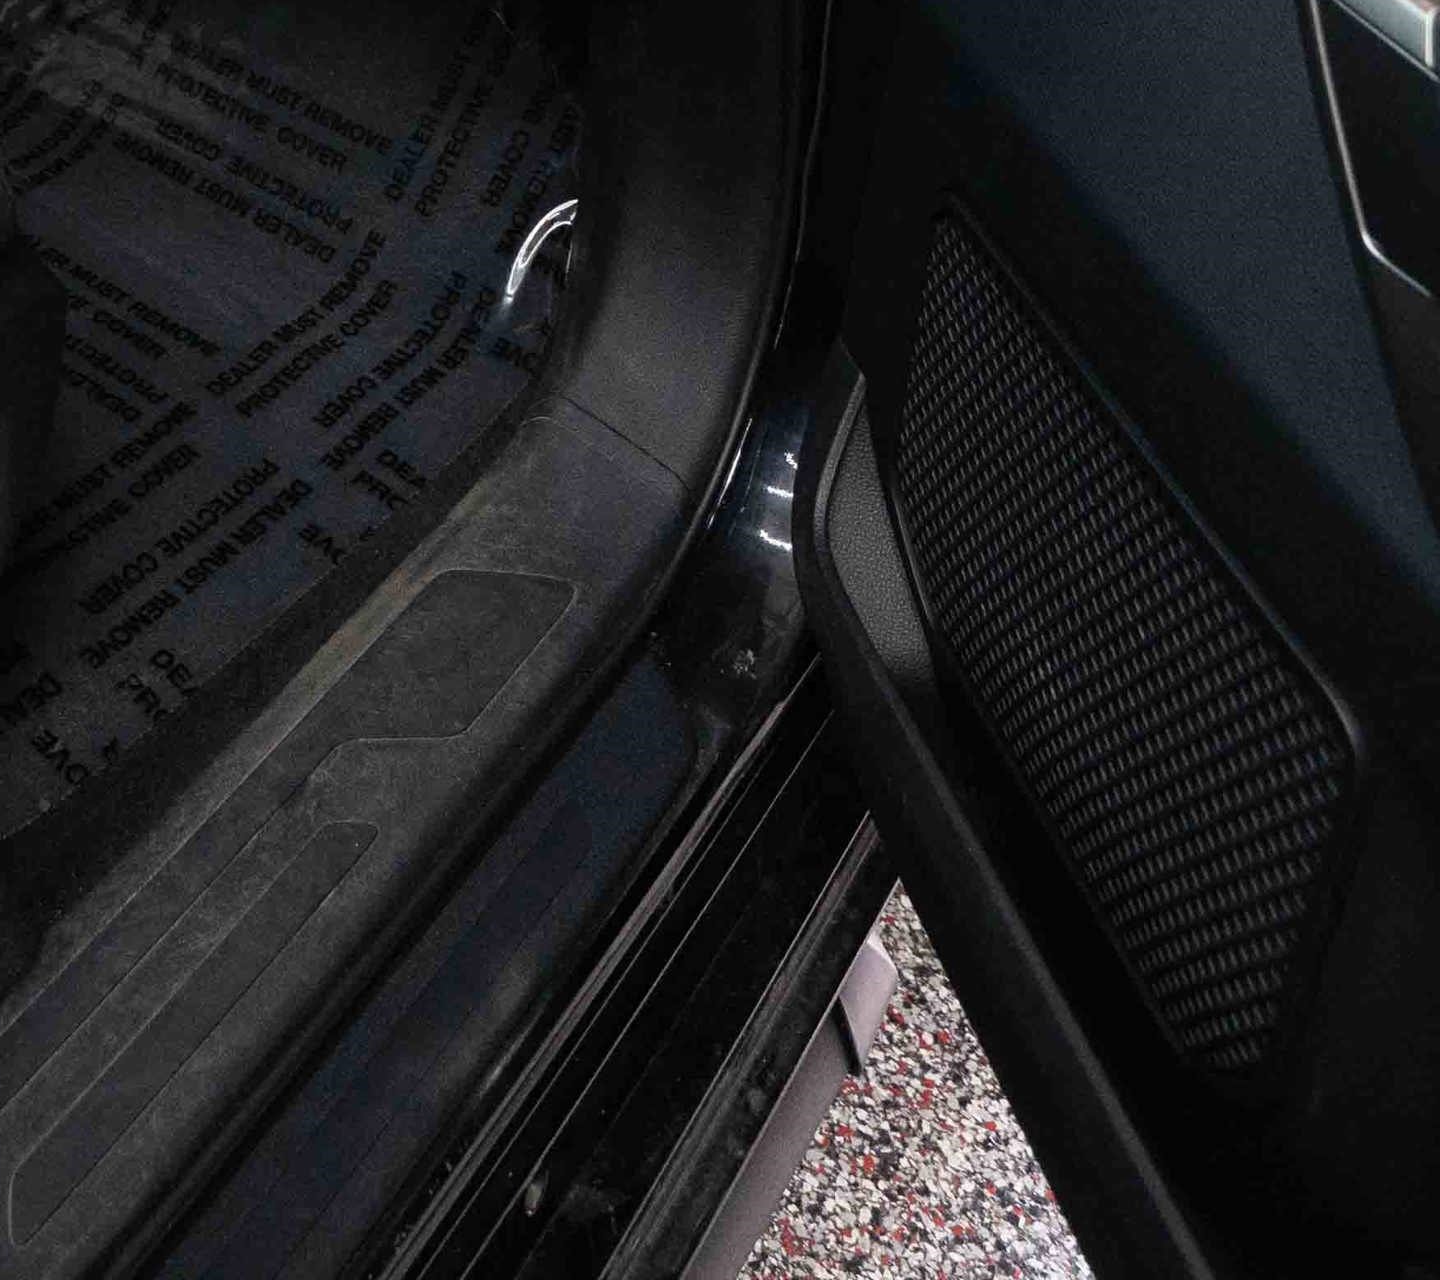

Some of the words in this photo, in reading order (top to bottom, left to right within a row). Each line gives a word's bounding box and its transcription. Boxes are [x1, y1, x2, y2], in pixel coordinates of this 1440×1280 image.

[246, 69, 302, 111] MUST
[304, 102, 394, 156] REMOVE
[110, 129, 194, 186] REMOVE
[278, 126, 348, 175] COVER
[384, 114, 438, 203] DEALER
[481, 129, 531, 207] COVER
[193, 177, 252, 218] MUST
[252, 205, 337, 264] DEALER
[69, 263, 132, 305] MUST
[126, 300, 221, 358] REMOVE
[92, 308, 169, 362] COVER
[205, 339, 280, 397] DEALER
[272, 305, 326, 342] MUST
[319, 230, 387, 313] REMOVE
[372, 269, 468, 382] PROTECTIVE
[436, 286, 498, 370] DEALER
[235, 332, 347, 419] PROTECTIVE
[339, 279, 398, 337] COVER
[312, 375, 379, 429] COVER
[393, 365, 448, 416] MUST
[127, 443, 202, 498] COVER
[320, 400, 401, 472] REMOVE
[155, 457, 282, 560] PROTECTIVE
[230, 477, 315, 545] DEALER
[77, 551, 160, 615] COVER
[173, 539, 241, 595] MUST
[78, 588, 182, 670] REMOVE
